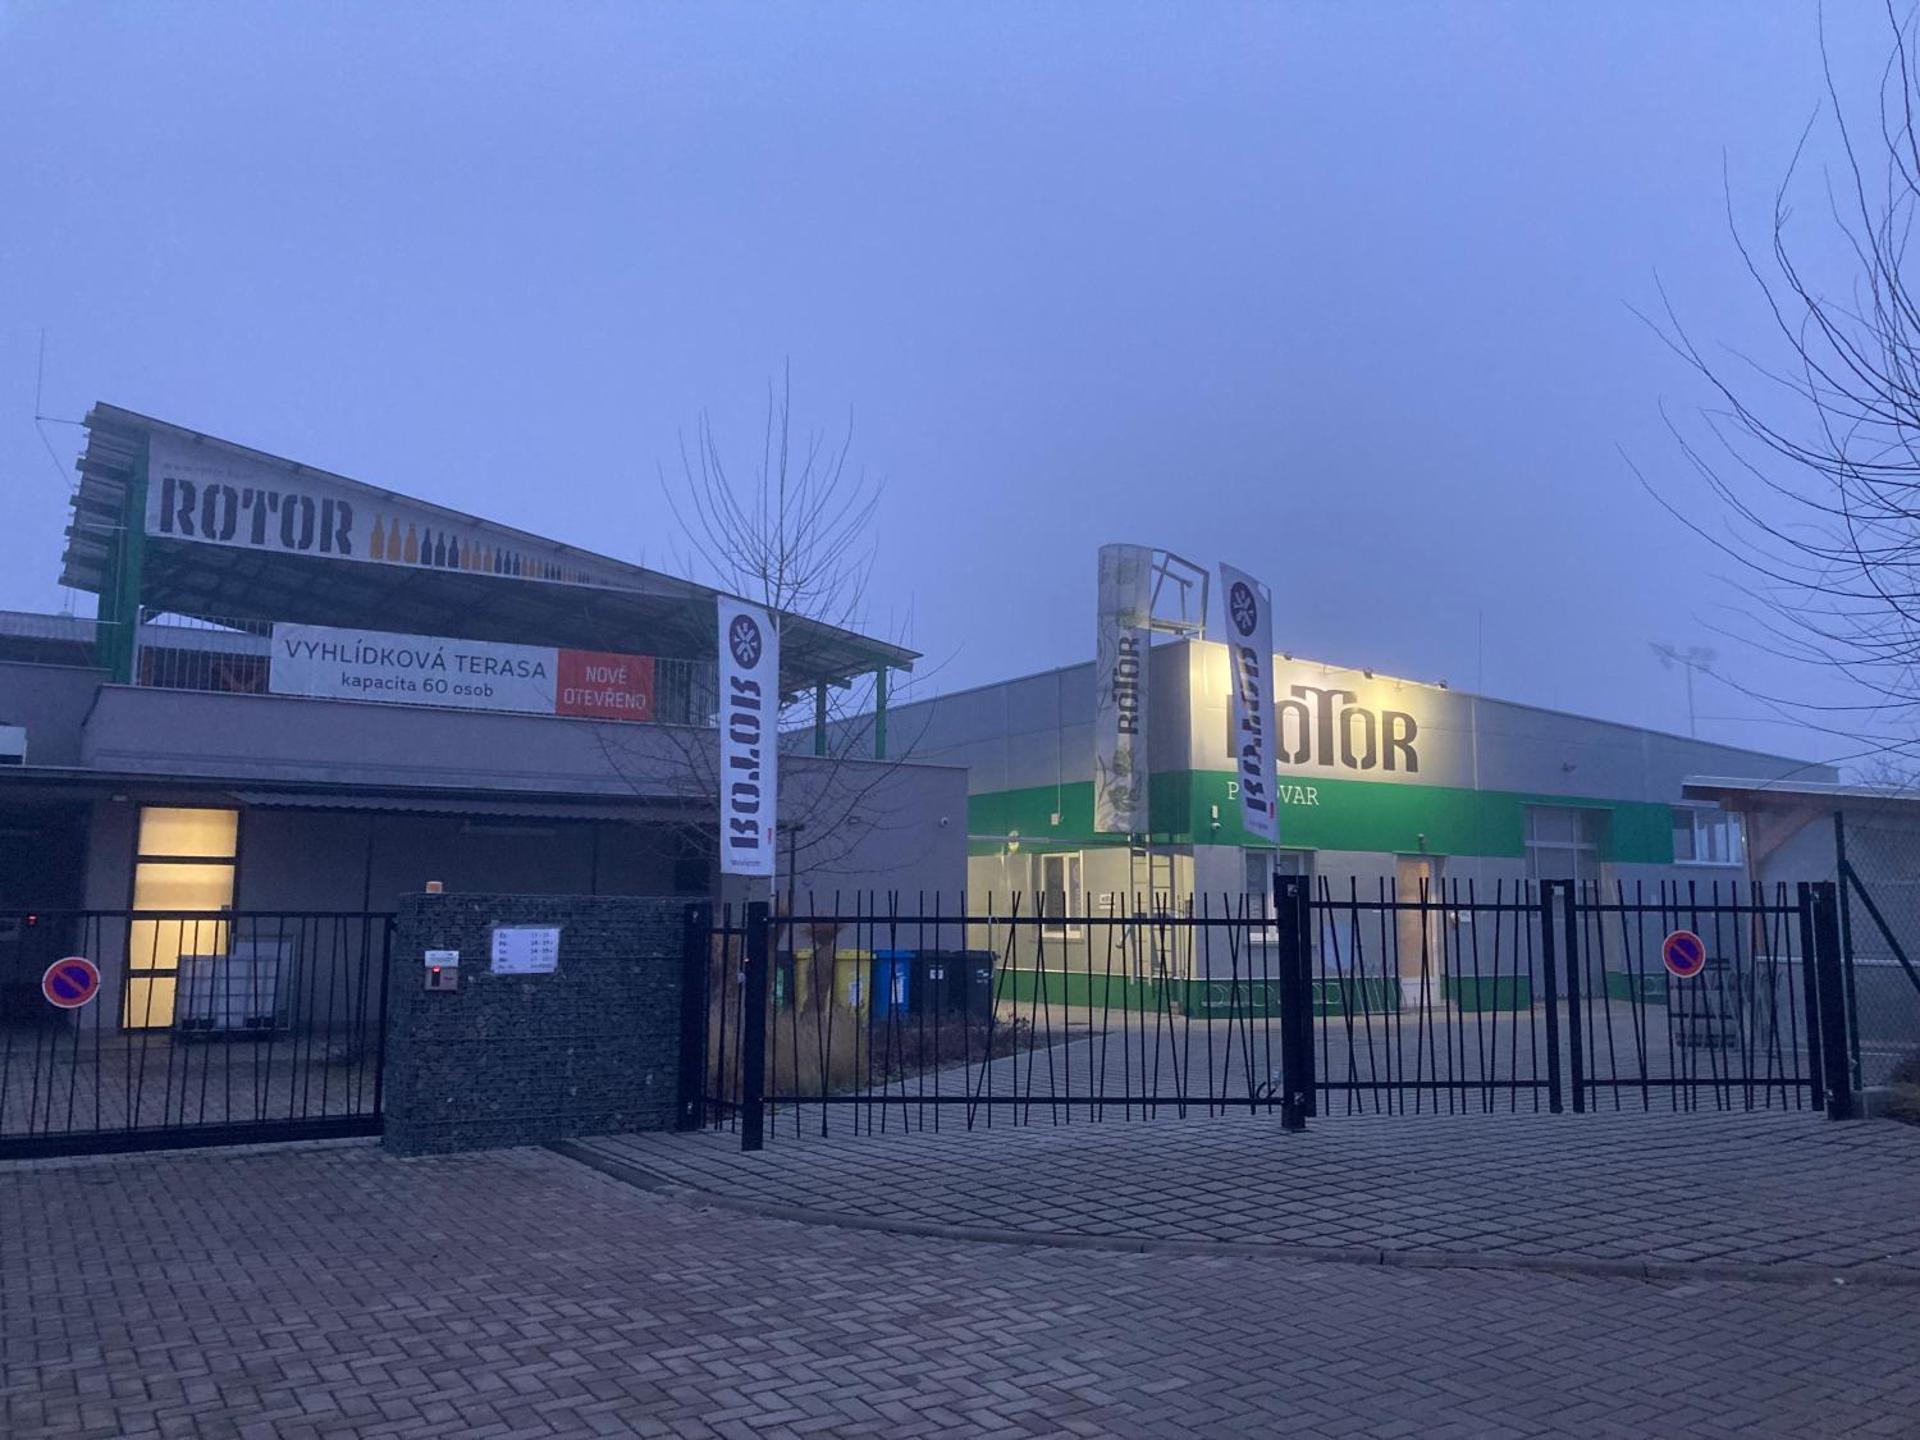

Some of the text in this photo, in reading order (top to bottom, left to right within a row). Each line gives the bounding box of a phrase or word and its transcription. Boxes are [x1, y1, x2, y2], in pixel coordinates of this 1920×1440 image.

[160, 477, 353, 555] ROTOR
[285, 638, 547, 679] VYHLÍDKOVÁ TERASA
[341, 671, 494, 697] kapacita 60 osob
[585, 664, 628, 686] NOVÉ
[1112, 636, 1139, 735] ROTOR
[564, 687, 647, 710] OTEVŘENO
[1227, 781, 1320, 806] PVAR
